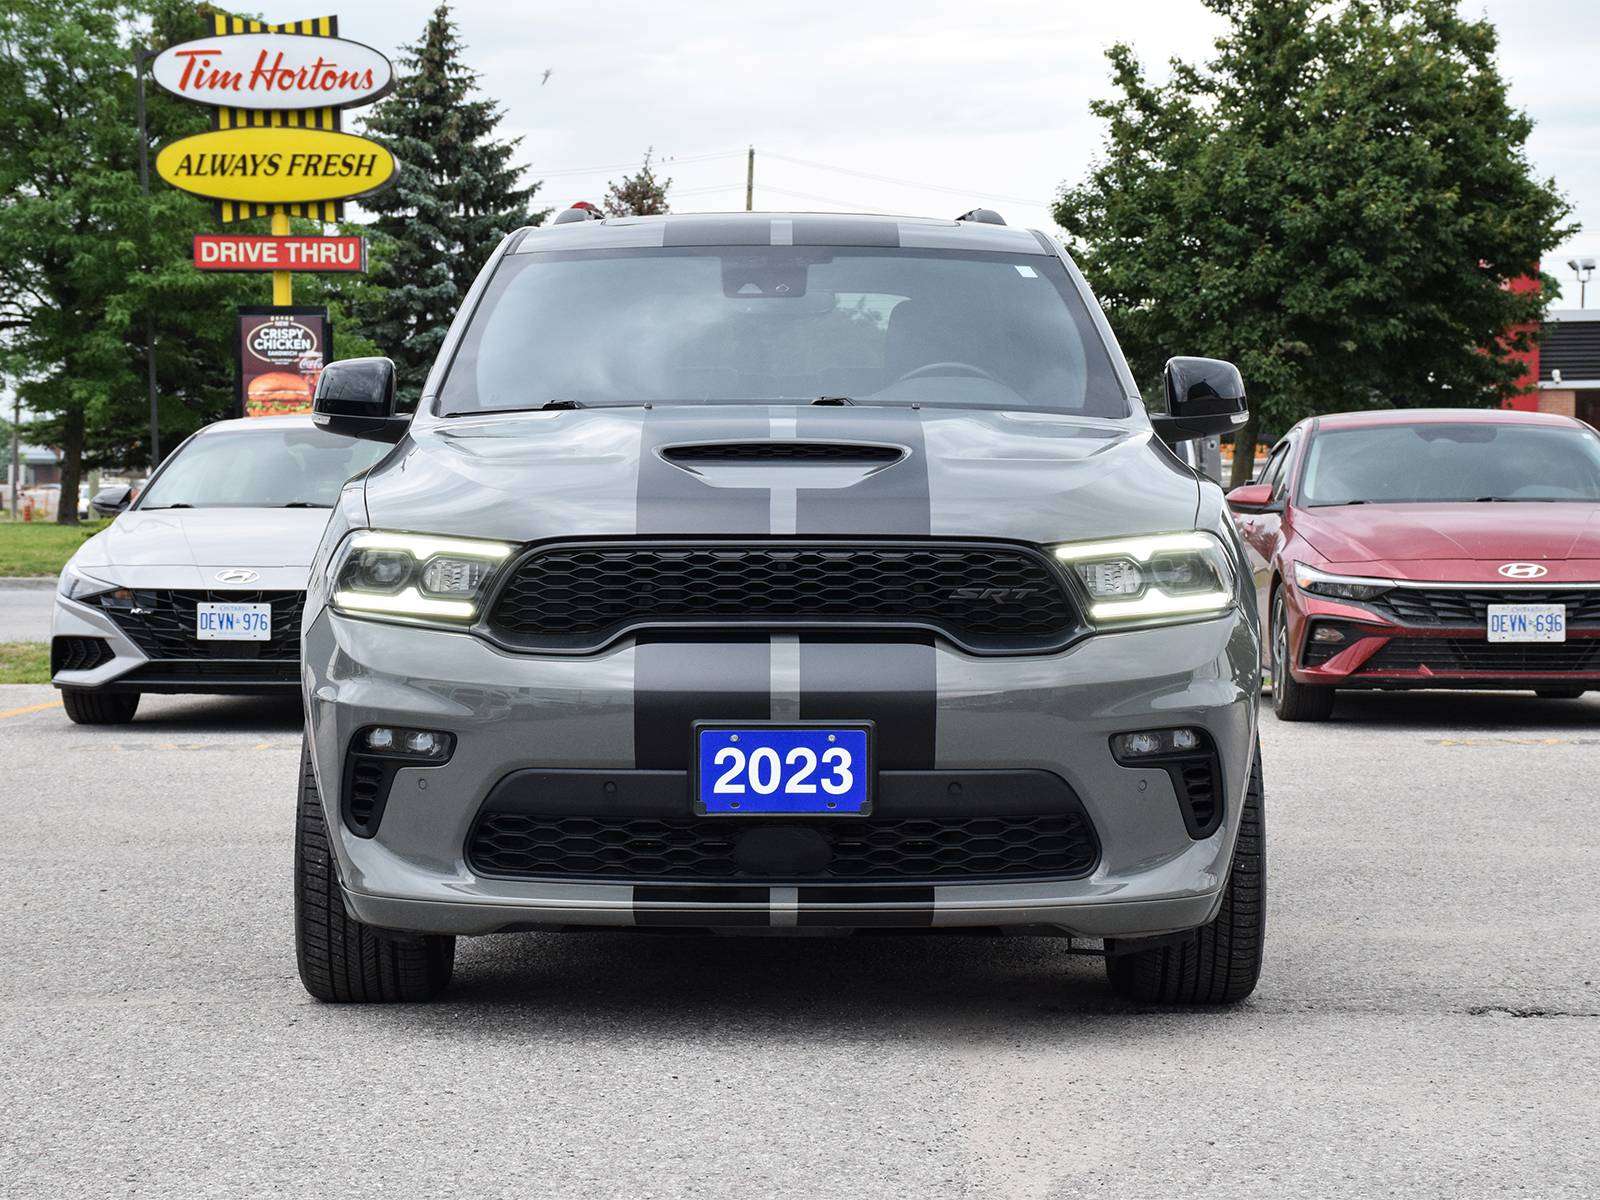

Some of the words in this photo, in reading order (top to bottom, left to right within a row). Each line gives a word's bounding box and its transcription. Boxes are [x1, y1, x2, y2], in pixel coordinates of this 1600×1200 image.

[175, 50, 243, 91] Tim
[248, 49, 374, 92] Hortons
[174, 153, 282, 176] ALWAYS
[286, 153, 378, 176] FRESH
[200, 241, 279, 263] DRIVE
[284, 243, 355, 264] THRU
[253, 339, 311, 350] CHICKEN
[260, 328, 304, 339] CRISPY
[948, 587, 1039, 604] SRT
[713, 746, 854, 795] 2023
